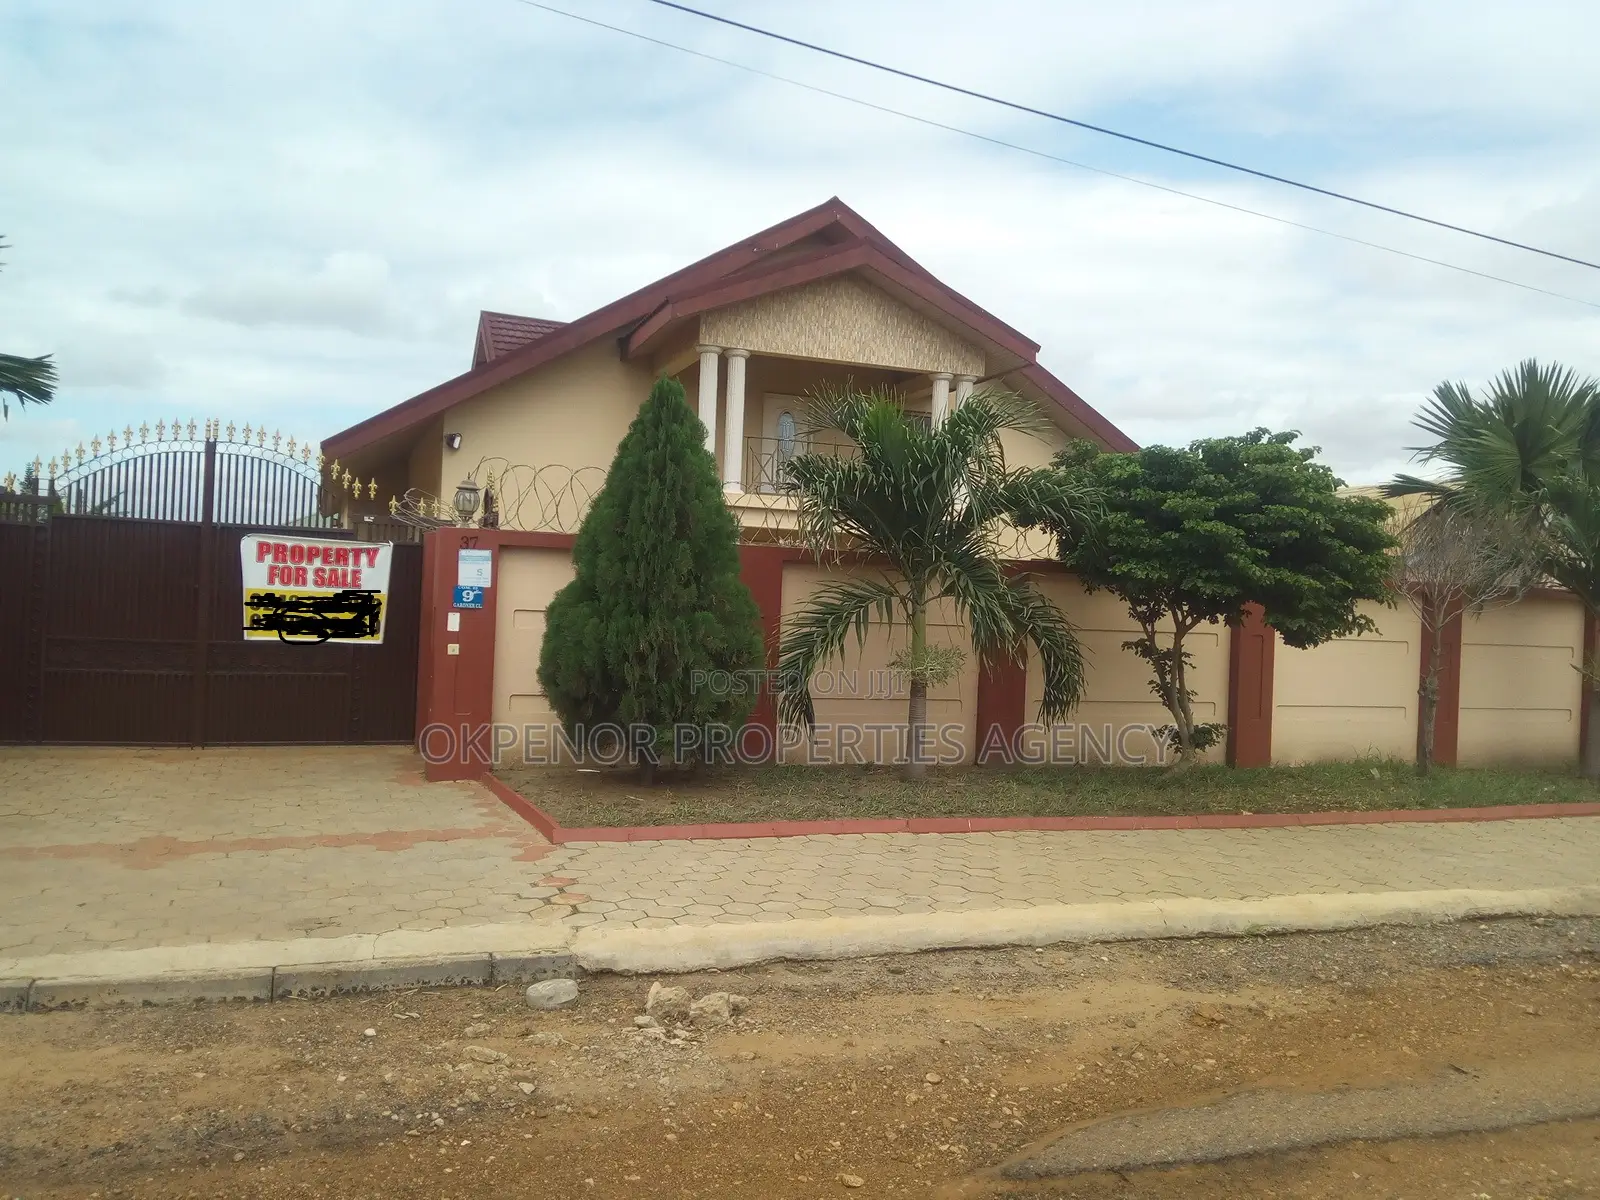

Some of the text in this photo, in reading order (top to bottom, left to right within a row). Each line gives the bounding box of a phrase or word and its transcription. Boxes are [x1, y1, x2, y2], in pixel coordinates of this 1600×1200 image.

[460, 536, 478, 549] 37
[256, 541, 380, 568] PROPERTY
[267, 565, 362, 588] FOR SALE
